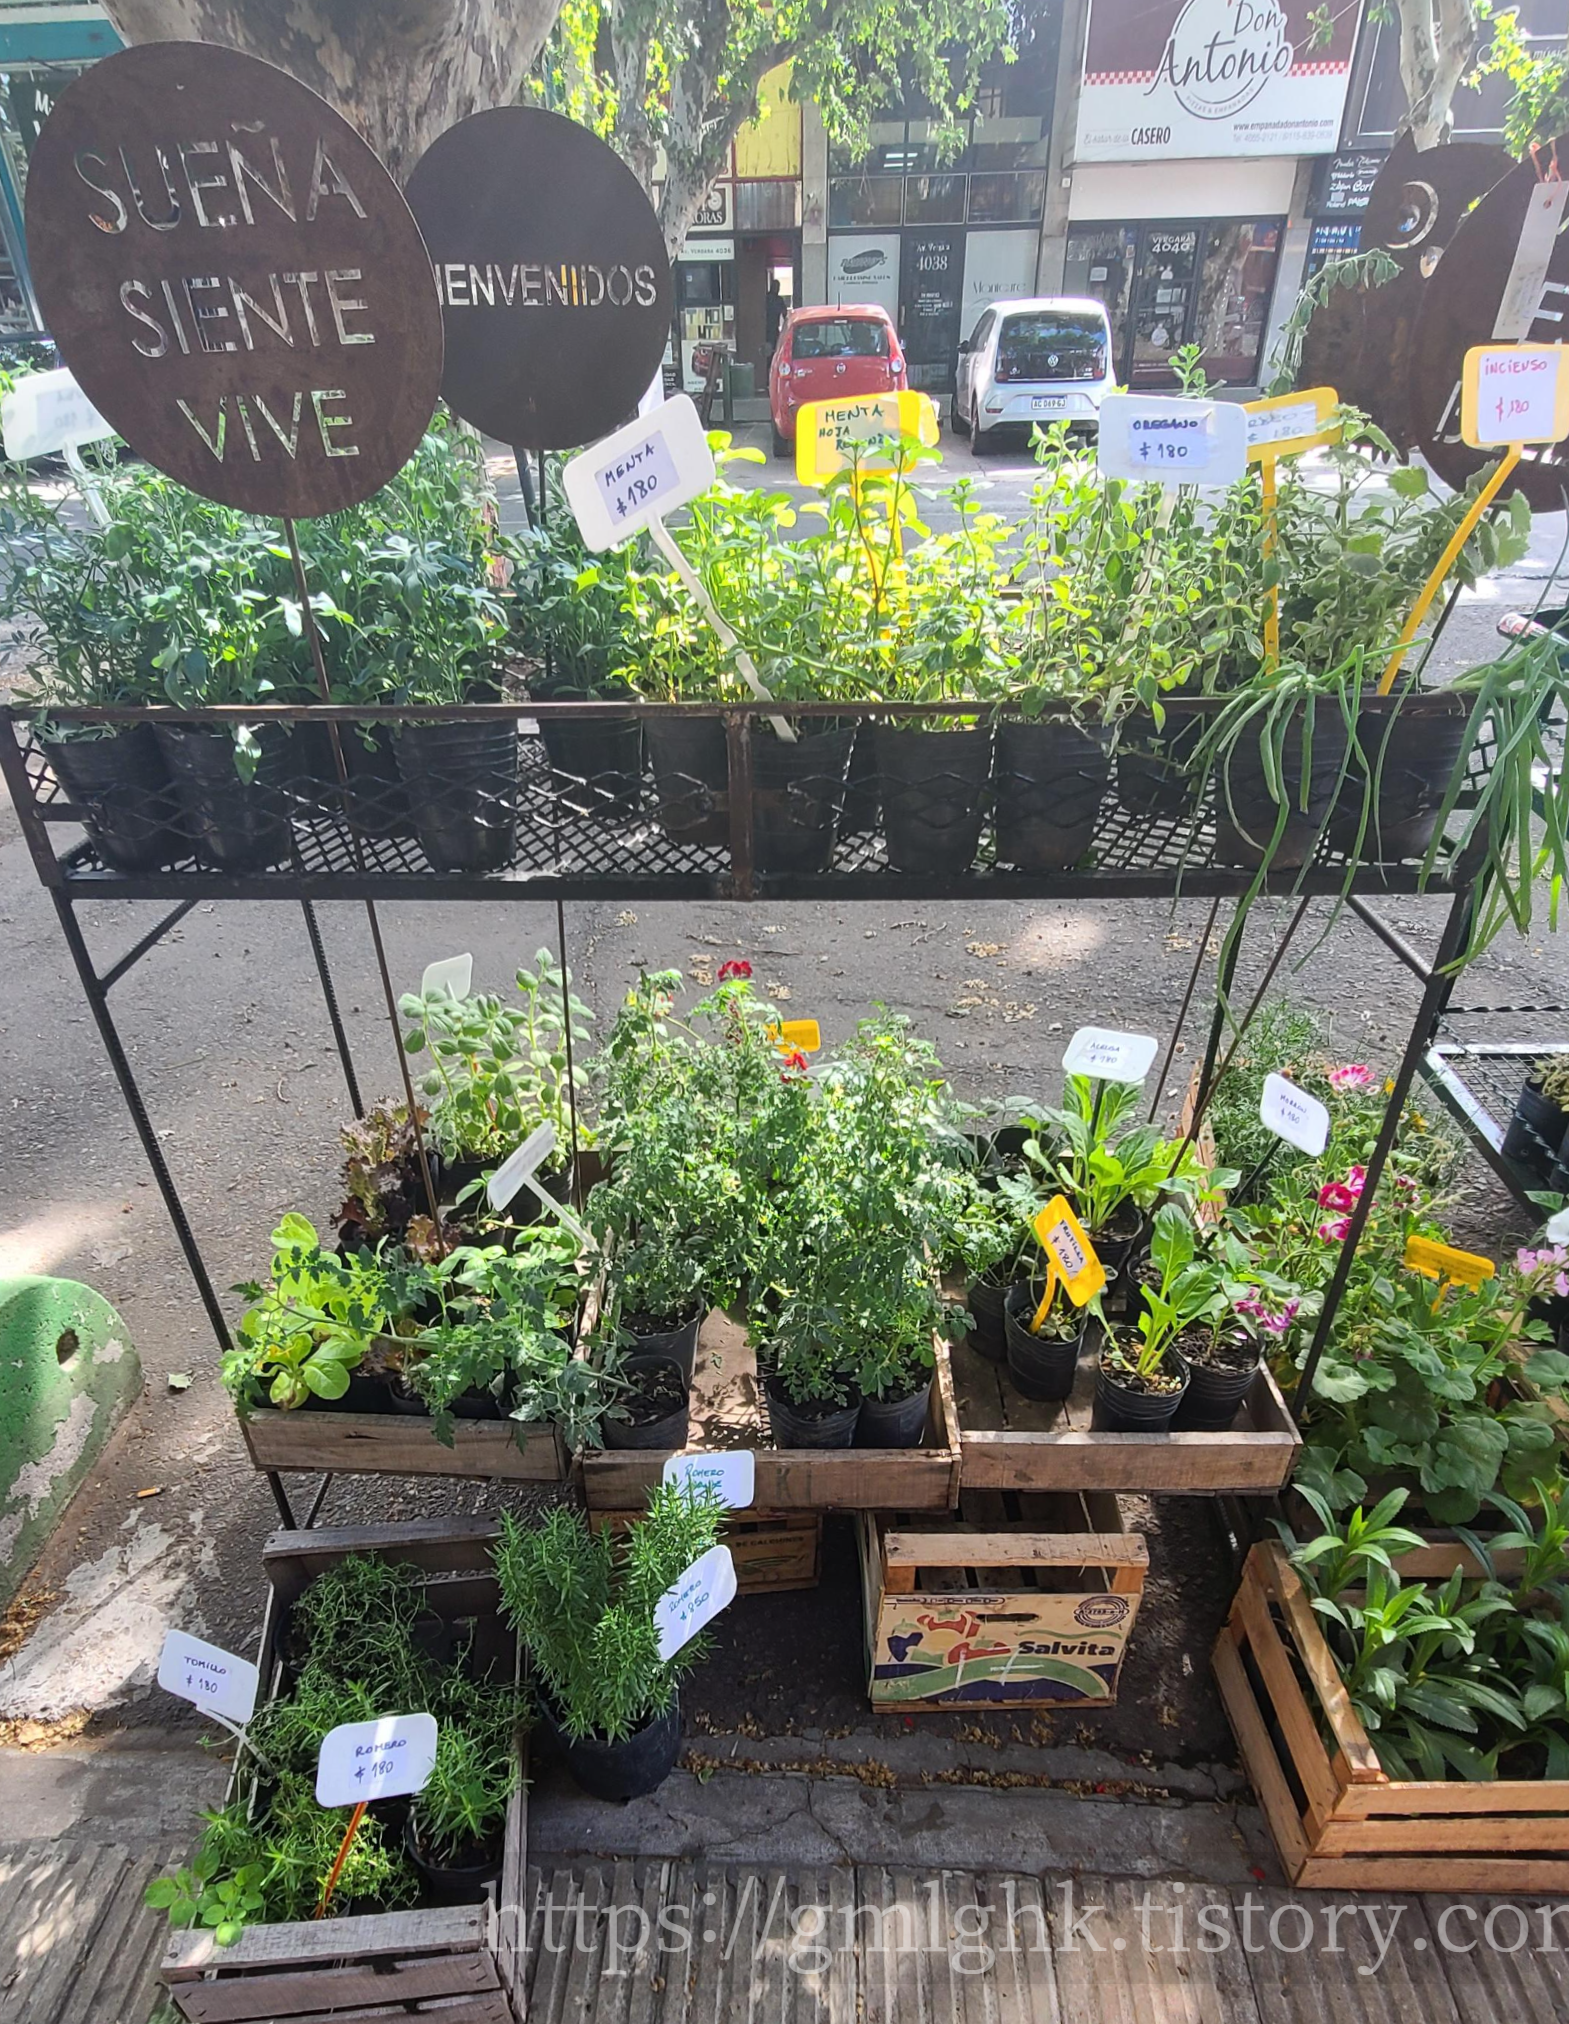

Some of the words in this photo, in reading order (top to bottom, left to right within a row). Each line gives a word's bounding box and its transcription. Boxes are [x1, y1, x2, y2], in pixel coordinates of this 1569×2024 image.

[1232, 0, 1284, 36] Don
[1143, 30, 1290, 97] Antonio
[1131, 127, 1171, 145] CASERO
[74, 119, 368, 234] SUEÑA
[692, 211, 723, 225] ORAS
[1152, 242, 1190, 254] 4040
[434, 263, 657, 307] IENVENIDOS
[119, 268, 376, 358] SIENTE
[177, 390, 360, 463] VIVE
[825, 404, 885, 432] MENTA
[1132, 418, 1199, 431] OREGANO
[818, 426, 850, 448] HOJA
[604, 443, 655, 488] MENTA
[1018, 1641, 1116, 1657] Salvita
[355, 1739, 407, 1758] ROMERO
